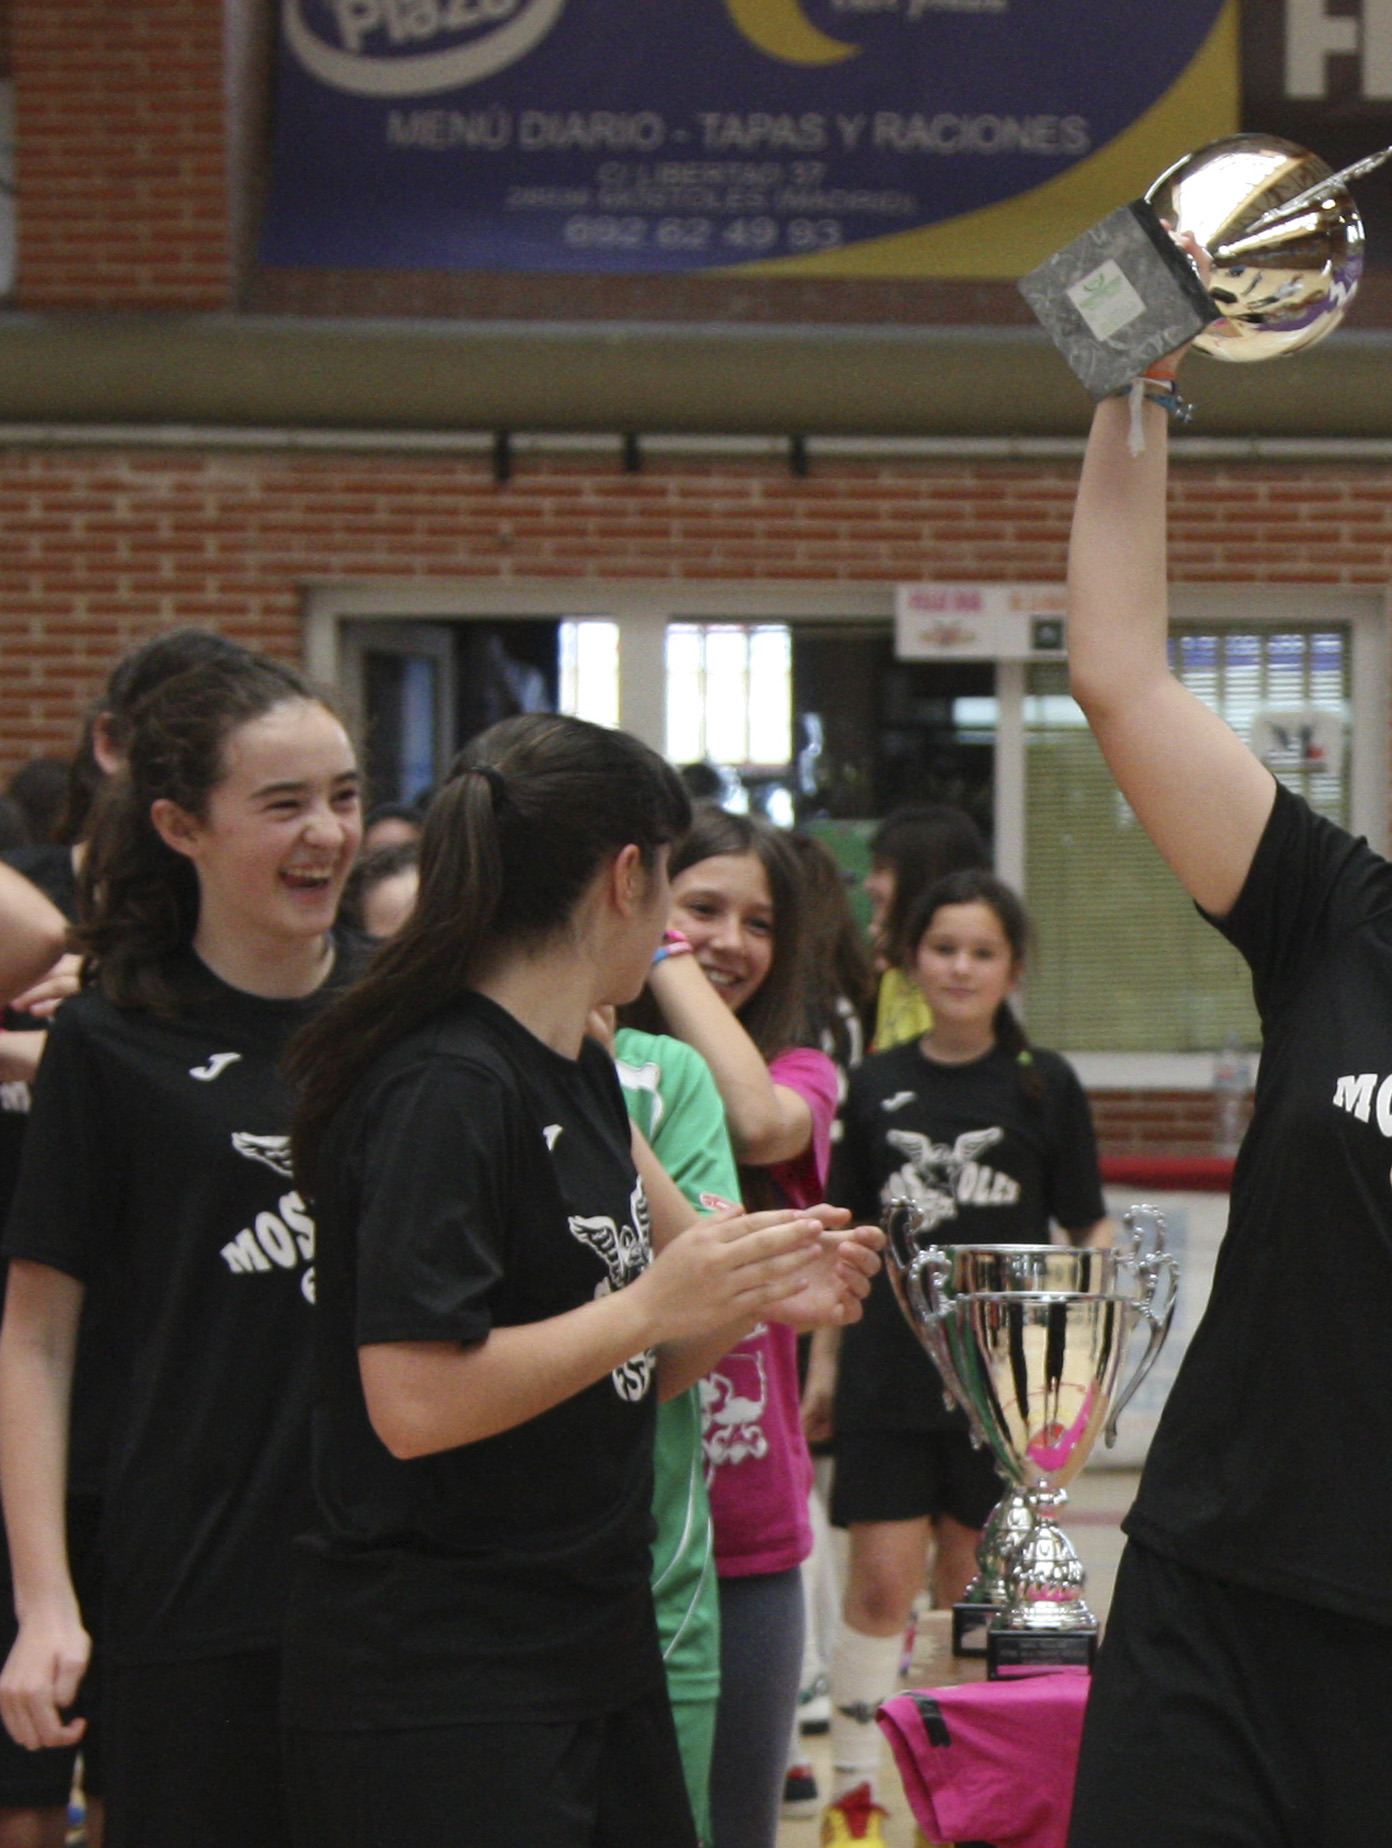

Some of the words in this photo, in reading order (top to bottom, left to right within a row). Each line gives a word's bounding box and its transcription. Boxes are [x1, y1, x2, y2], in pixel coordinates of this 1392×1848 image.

[519, 110, 664, 149] DIARIO
[702, 112, 826, 150] TAPAS
[836, 113, 867, 148] Y
[873, 112, 1090, 154] RACIONES
